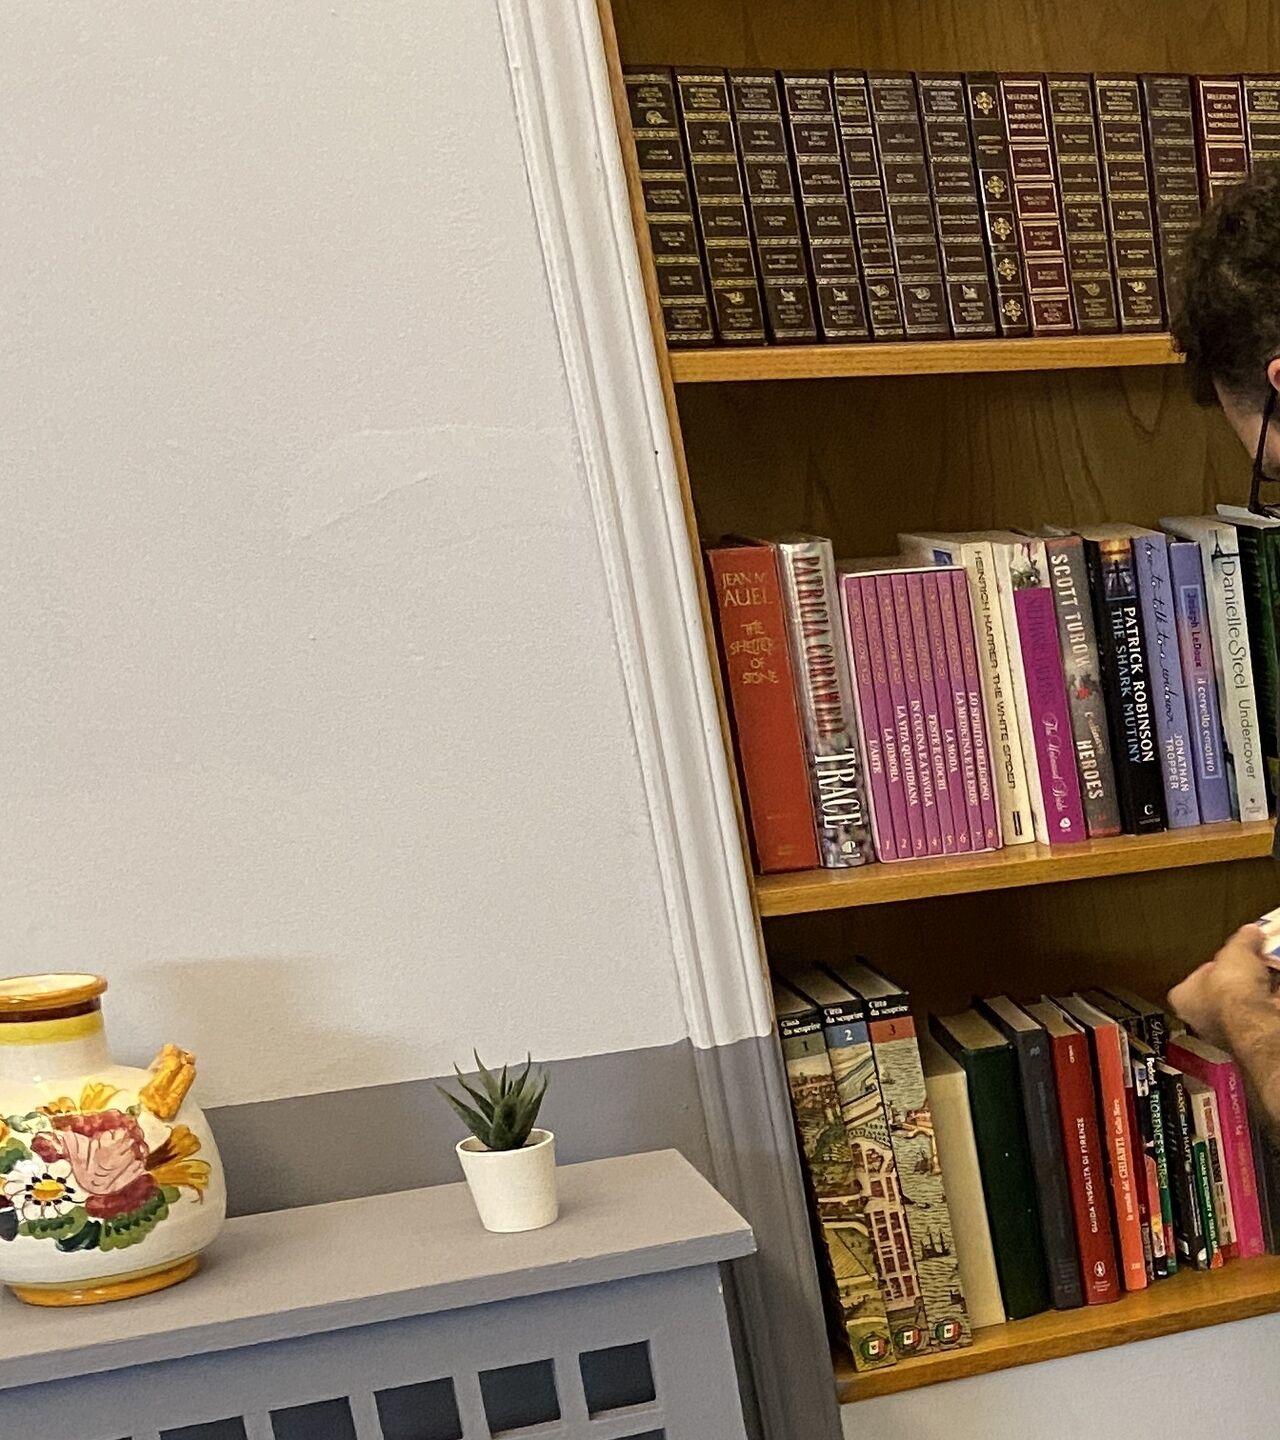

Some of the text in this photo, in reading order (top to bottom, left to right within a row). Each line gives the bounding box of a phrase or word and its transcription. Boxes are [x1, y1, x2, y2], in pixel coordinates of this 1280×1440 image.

[1145, 542, 1156, 565] how
[724, 587, 773, 607] AUEL
[792, 556, 831, 638] PATRICIA
[1152, 576, 1163, 593] to
[741, 620, 765, 636] THE
[1051, 554, 1091, 669] SCOTT TUROW
[1153, 599, 1167, 626] talk
[1158, 632, 1170, 648] to
[974, 550, 1016, 789] HEINRICH HARRER THE WHITE SPIDER
[1111, 607, 1141, 764] THE SHARK MUTINY
[1123, 606, 1155, 763] PATRICK ROBINSON
[1221, 560, 1257, 779] Danielle Steel Undercover
[1198, 686, 1210, 728] cervello
[898, 721, 909, 743] VITA
[929, 714, 940, 746] FESTE
[912, 713, 925, 751] CUCINA
[920, 769, 933, 807] TAVOLA
[946, 744, 958, 773] MODA
[1076, 740, 1104, 800] HEROES
[1165, 736, 1179, 790] TROPPER
[1174, 733, 1190, 792] JONATHAN
[1203, 730, 1215, 772] emotivo
[814, 747, 863, 829] TRACE
[900, 744, 918, 806] QUOTIDIANA
[934, 755, 946, 791] GIOCHI
[783, 1028, 793, 1036] da
[826, 1016, 835, 1024] da
[844, 1029, 853, 1041] 2
[888, 1024, 897, 1036] 3
[803, 1041, 809, 1051] 1
[1176, 1083, 1187, 1115] CHANT
[1150, 1090, 1164, 1154] FLORENCE'S
[1077, 1117, 1098, 1233] GUIDA INSOLITA DI FIRENZE
[1115, 1137, 1128, 1178] CHIANTI
